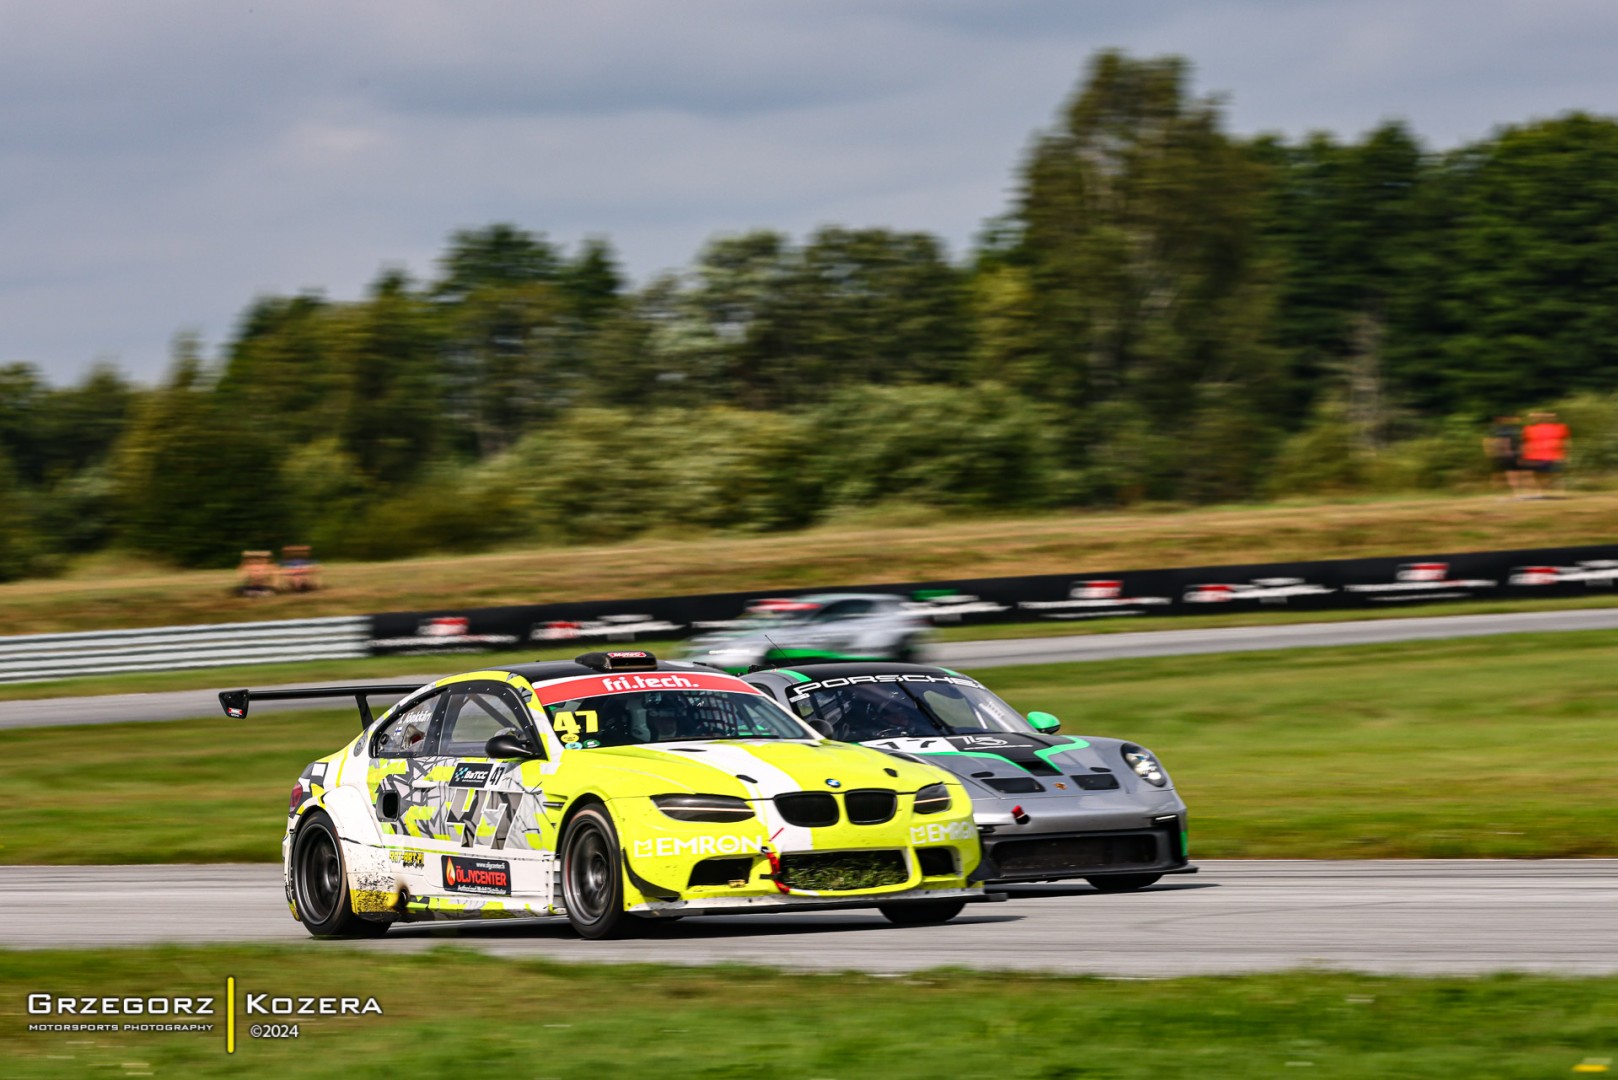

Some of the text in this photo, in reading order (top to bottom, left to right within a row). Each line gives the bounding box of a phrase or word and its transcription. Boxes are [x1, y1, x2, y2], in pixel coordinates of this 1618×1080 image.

[602, 675, 700, 691] fri.tech.
[793, 675, 979, 695] PORSCHE
[553, 710, 599, 734] 47
[489, 766, 506, 786] 47
[445, 787, 526, 851] 47
[655, 835, 763, 857] EMRON
[455, 865, 507, 887] ÖLJYCENTER
